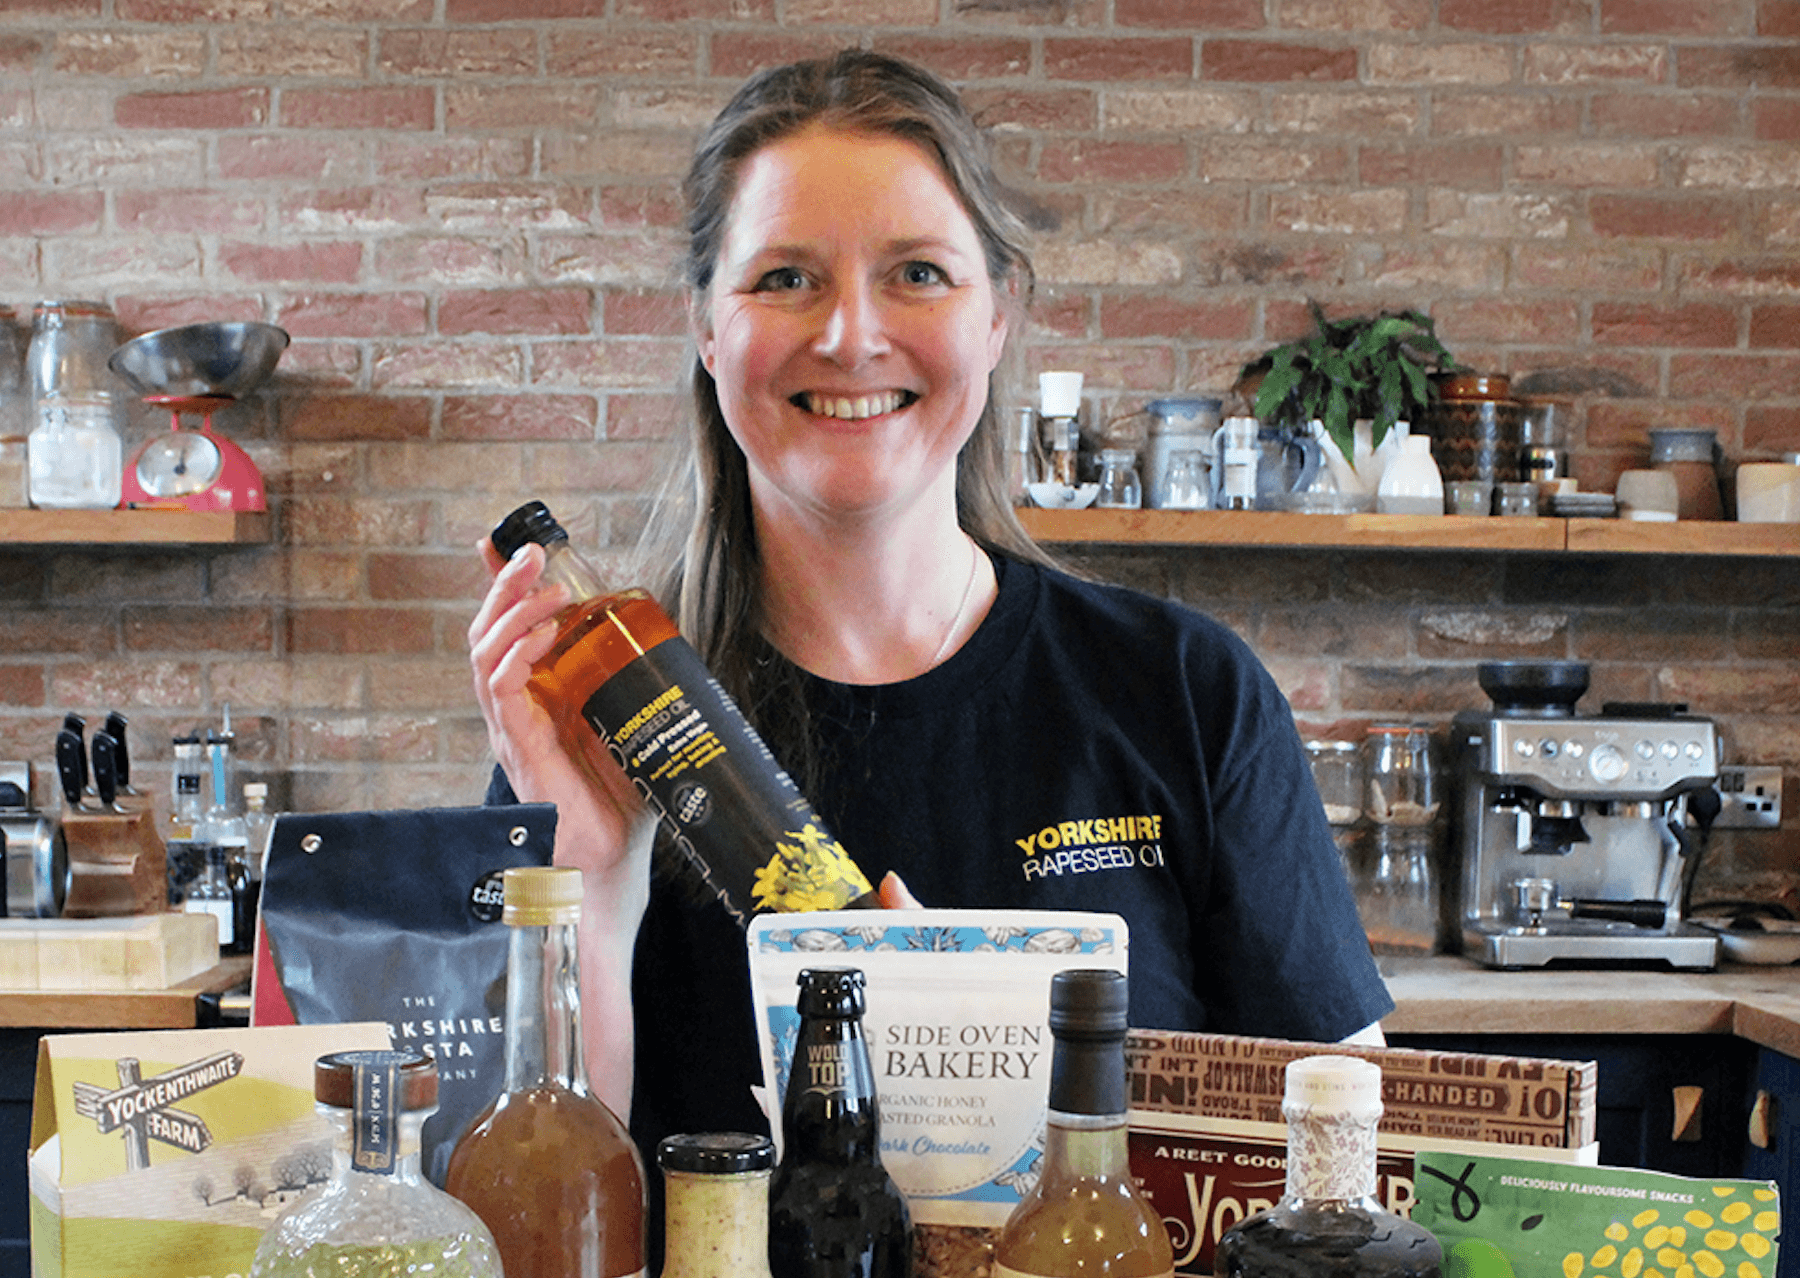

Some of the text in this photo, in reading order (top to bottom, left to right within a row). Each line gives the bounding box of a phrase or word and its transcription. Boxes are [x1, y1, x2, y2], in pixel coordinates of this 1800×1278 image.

[614, 684, 684, 744] YORKSHIRE
[638, 739, 661, 762] Cold
[657, 709, 702, 744] Pressed
[680, 787, 707, 823] taste
[1015, 815, 1162, 857] YORKSHIRE
[1023, 844, 1165, 881] RAPESEED OI
[472, 886, 504, 905] tast
[386, 1017, 503, 1039] RKSHIRE
[886, 1025, 1041, 1046] SIDE OVEN
[807, 1044, 849, 1062] WOLD
[885, 1051, 1039, 1079] BAKERY
[808, 1062, 850, 1086] TOP
[1203, 1061, 1287, 1096] SWALLOP
[107, 1056, 236, 1125] YOCKENTHWAITE
[880, 1093, 987, 1108] RGANIC HONEY
[151, 1113, 201, 1150] FARM
[880, 1112, 997, 1127] ASTED GRANOLA
[880, 1135, 991, 1156] ark Chocolate
[1233, 1154, 1287, 1169] GOO
[1500, 1176, 1695, 1204] DELICIOUSLY FLAVOURSOME SNACKS
